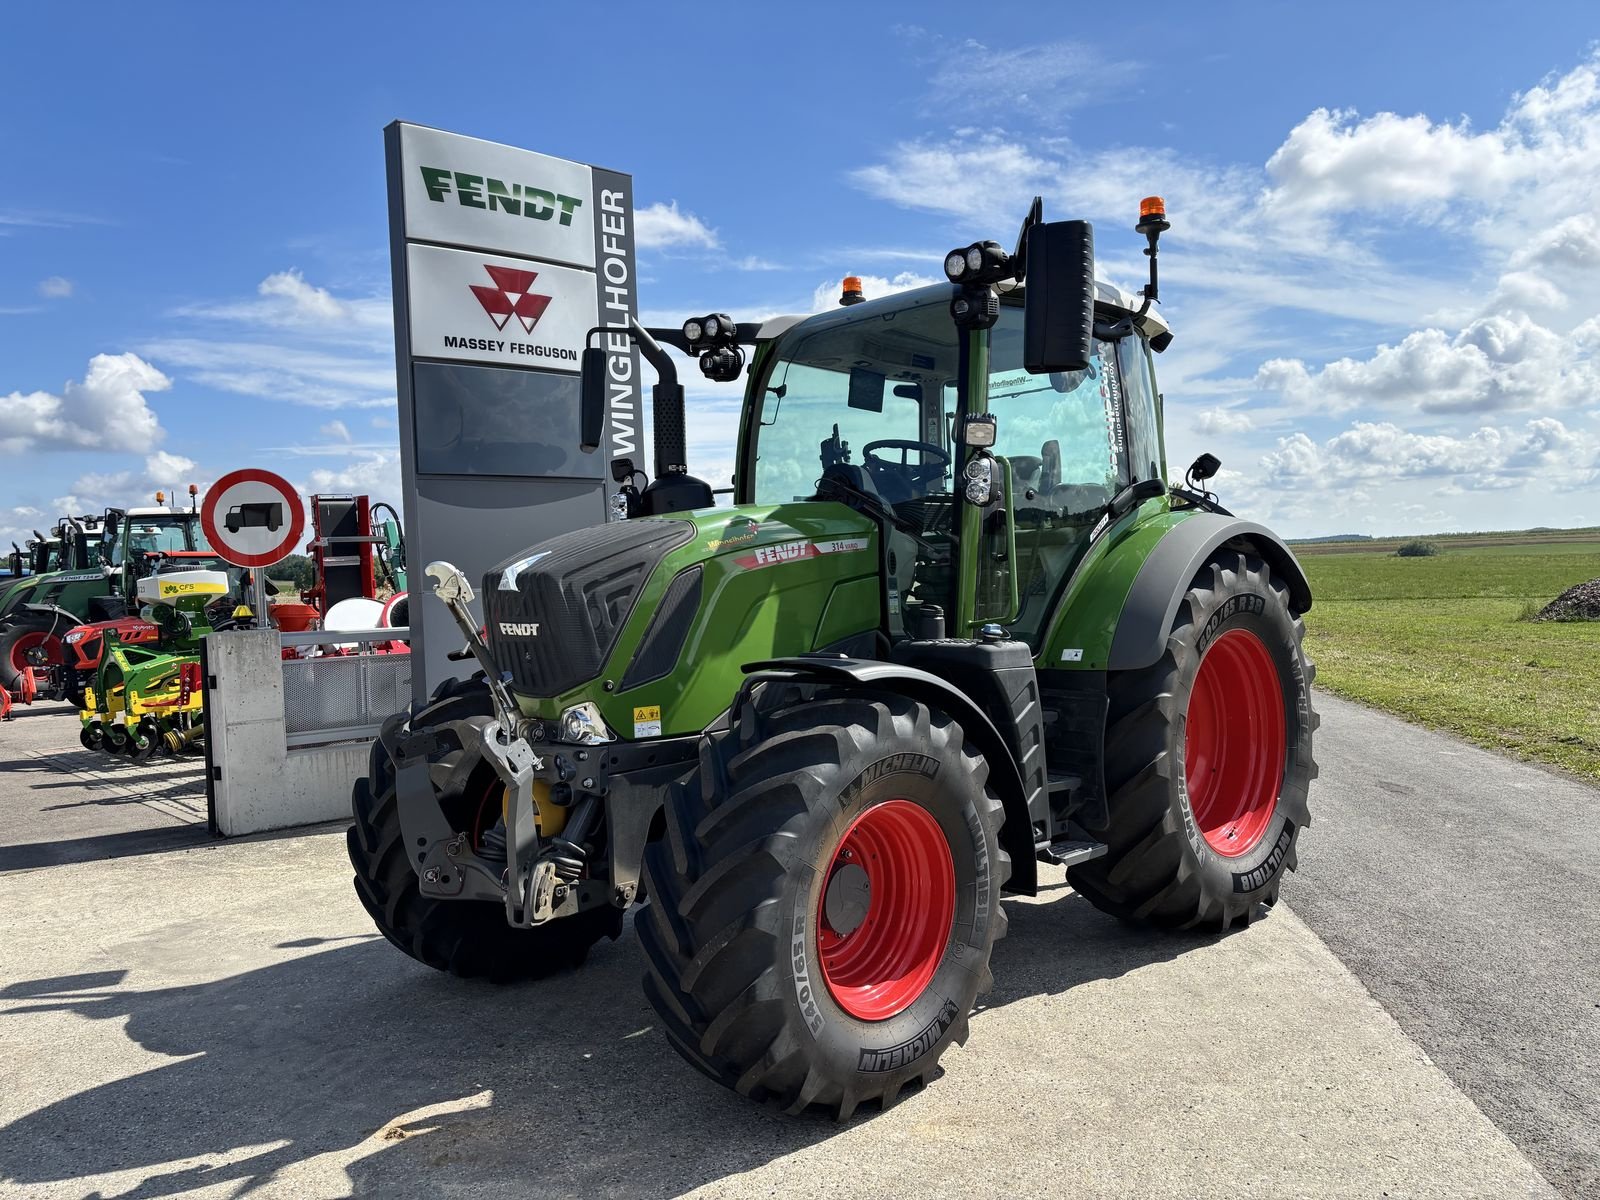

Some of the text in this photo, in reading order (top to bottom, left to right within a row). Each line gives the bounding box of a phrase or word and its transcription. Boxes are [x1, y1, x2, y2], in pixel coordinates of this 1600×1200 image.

[420, 166, 583, 227] FENDT
[444, 336, 577, 361] MASSEY FERGUSON
[601, 189, 636, 457] WINGELHOFER
[754, 541, 808, 564] FENDT
[831, 542, 844, 552] 314
[499, 622, 539, 636] FENDT
[862, 754, 939, 787] MICHELIN
[967, 813, 990, 932] MULTIBIB
[1240, 830, 1291, 891] MULTIBIB
[793, 940, 822, 1034] 540/65
[859, 1019, 941, 1072] MICHELIN
